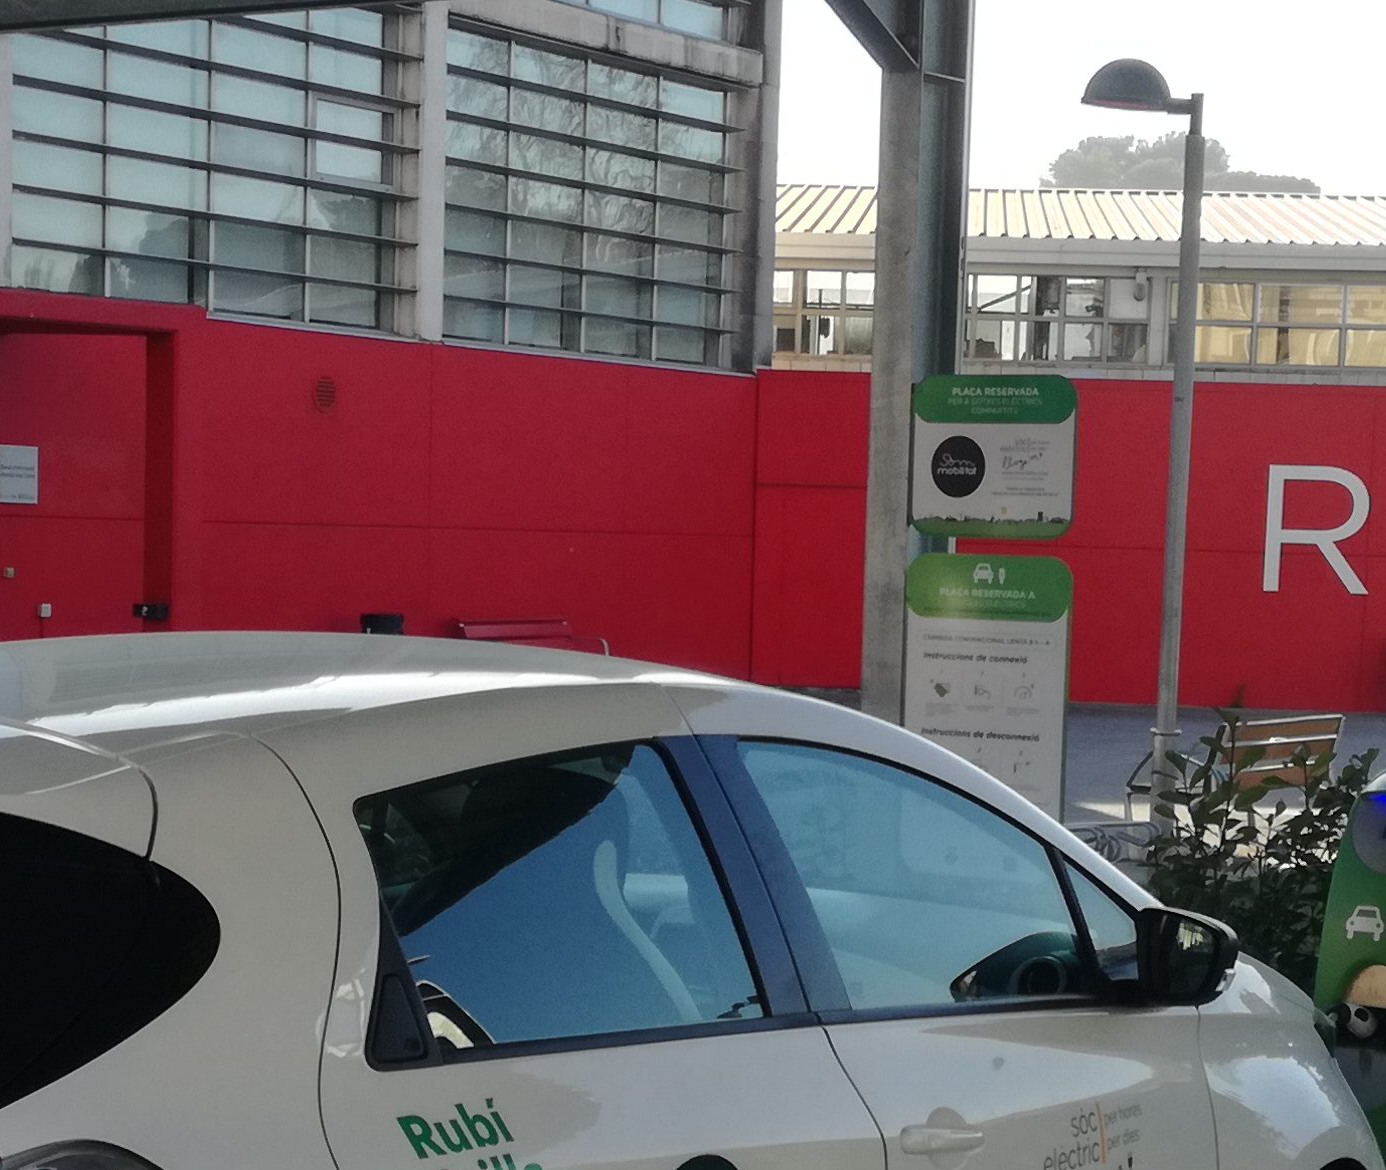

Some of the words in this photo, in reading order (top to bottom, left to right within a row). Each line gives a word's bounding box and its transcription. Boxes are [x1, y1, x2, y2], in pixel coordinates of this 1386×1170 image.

[984, 387, 1039, 397] RESERVADA
[937, 466, 977, 476] mobilitat
[971, 588, 1027, 599] RESERVADA
[923, 652, 973, 662] Instruccions
[976, 653, 987, 663] de
[921, 727, 971, 738] Instruccions
[973, 730, 984, 739] de
